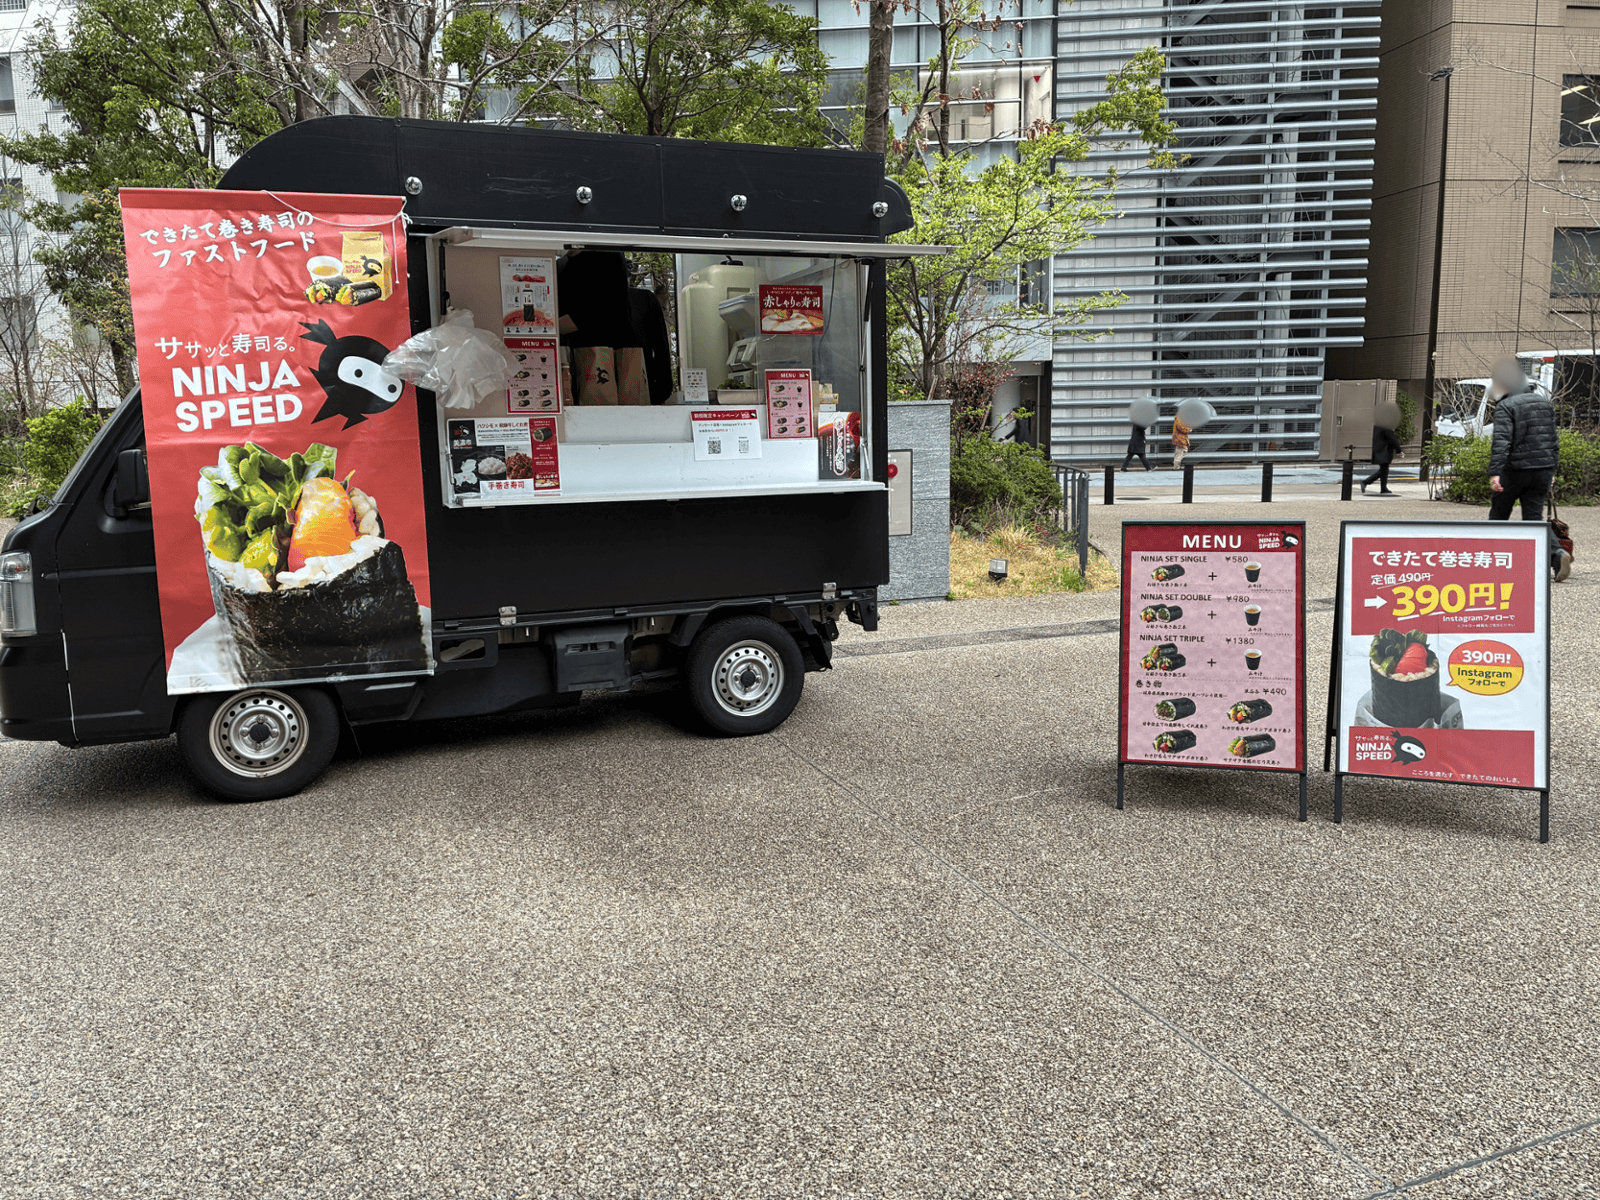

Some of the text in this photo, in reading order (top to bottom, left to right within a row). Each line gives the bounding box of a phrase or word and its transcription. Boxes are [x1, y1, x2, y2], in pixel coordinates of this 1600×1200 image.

[140, 211, 314, 245] できたて巻き寿司の
[152, 232, 315, 268] ファストフード
[763, 294, 820, 308] 赤しゃりの寿司
[154, 332, 295, 359] ササッと寿司る。
[172, 359, 300, 397] NINJA
[176, 394, 303, 432] SPEED
[488, 481, 525, 490] 手巻き寿司
[1182, 534, 1242, 549] MENU
[1141, 555, 1163, 563] NINJA
[1369, 550, 1513, 569] できたて巻き寿司
[1371, 572, 1432, 585] 定価 490円
[1141, 593, 1163, 601] NINJA
[1180, 594, 1212, 602] DOUBLE
[1226, 595, 1250, 603] ¥980
[1392, 582, 1514, 617] 390円!
[1139, 634, 1163, 642] NINJA
[1180, 635, 1206, 643] TRIPLE
[1225, 637, 1255, 645] ¥1380
[1462, 650, 1511, 664] 390円!
[1457, 668, 1512, 679] Instagram
[1135, 680, 1163, 688] 巻き物
[1468, 678, 1506, 687] フォローで
[1262, 688, 1287, 696] ¥490
[1356, 742, 1392, 751] NINJA
[1355, 751, 1392, 761] SPEED
[1412, 769, 1520, 784] こころを満たす できたてのおいしさ。
